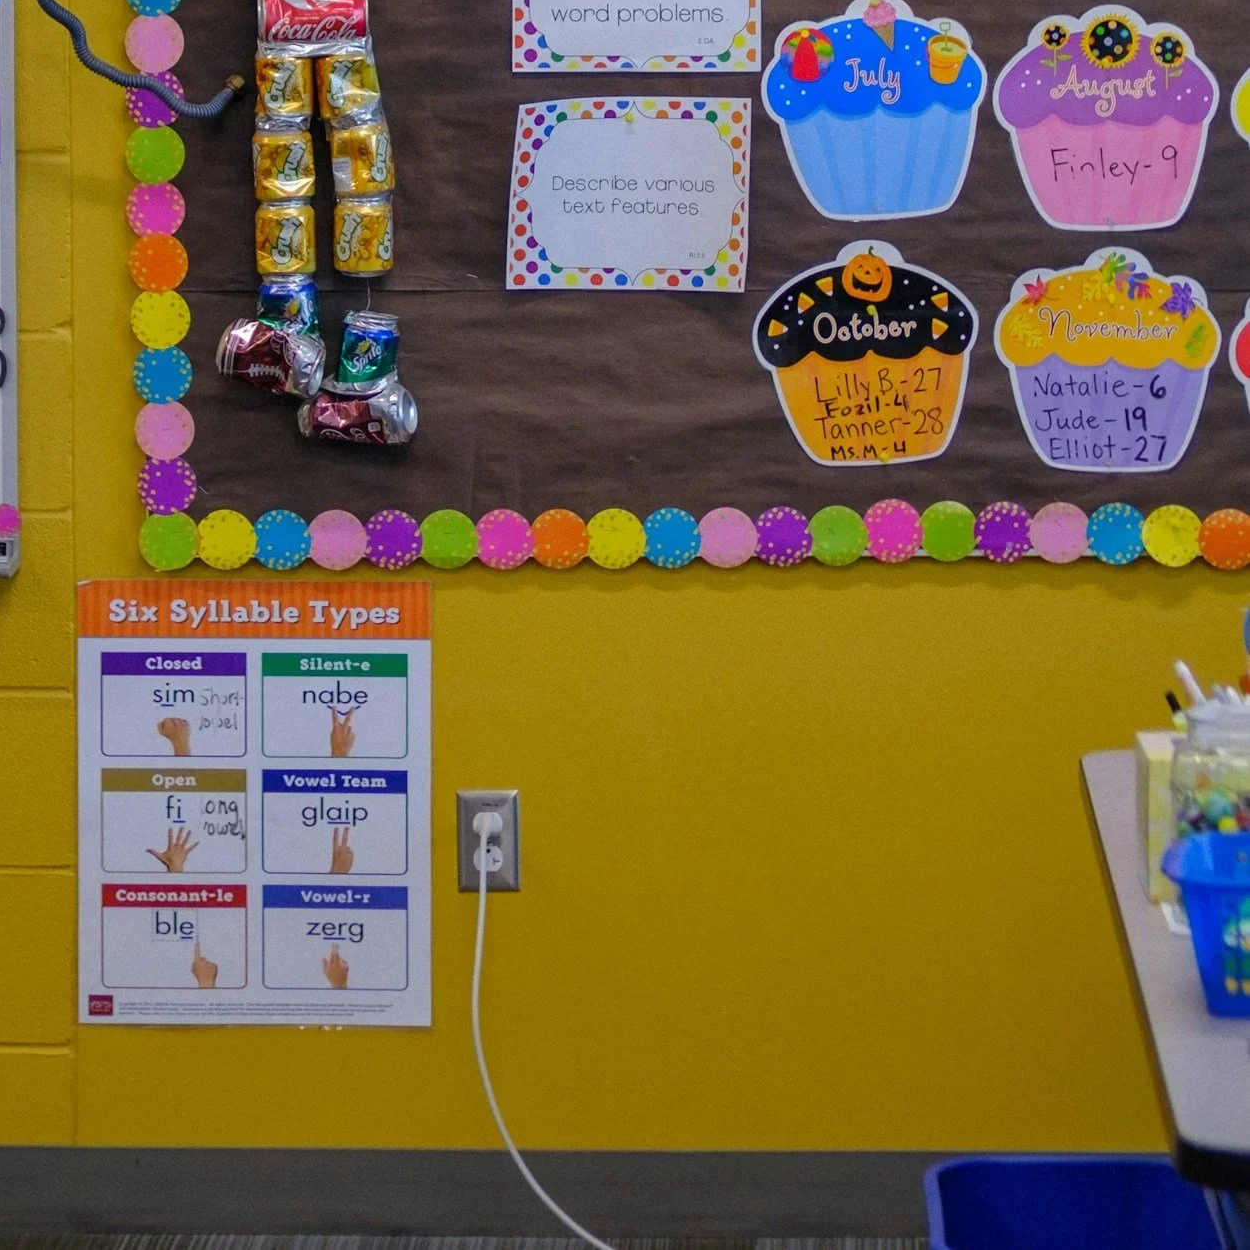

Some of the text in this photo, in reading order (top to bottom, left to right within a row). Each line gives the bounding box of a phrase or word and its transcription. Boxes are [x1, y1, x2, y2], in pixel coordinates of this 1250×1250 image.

[552, 4, 609, 22] word
[844, 58, 900, 104] July
[1050, 64, 1156, 117] August
[552, 175, 715, 193] Describe various
[563, 198, 698, 215] text features
[813, 312, 917, 344] October
[1039, 307, 1177, 342] November
[353, 346, 382, 374] Sprite
[109, 599, 400, 629] Six Syllable Types
[146, 657, 202, 671] Closed
[300, 658, 370, 671] Silent-e
[153, 683, 194, 704] sim
[303, 680, 368, 704] nabe
[152, 774, 196, 788] Open
[283, 775, 387, 788] Vowel Team
[166, 796, 184, 819] fi
[302, 797, 368, 826] glaip
[116, 890, 233, 902] Consonant-le
[301, 890, 370, 903] Vowel-r
[155, 911, 194, 935] ble
[306, 921, 364, 943] zerg
